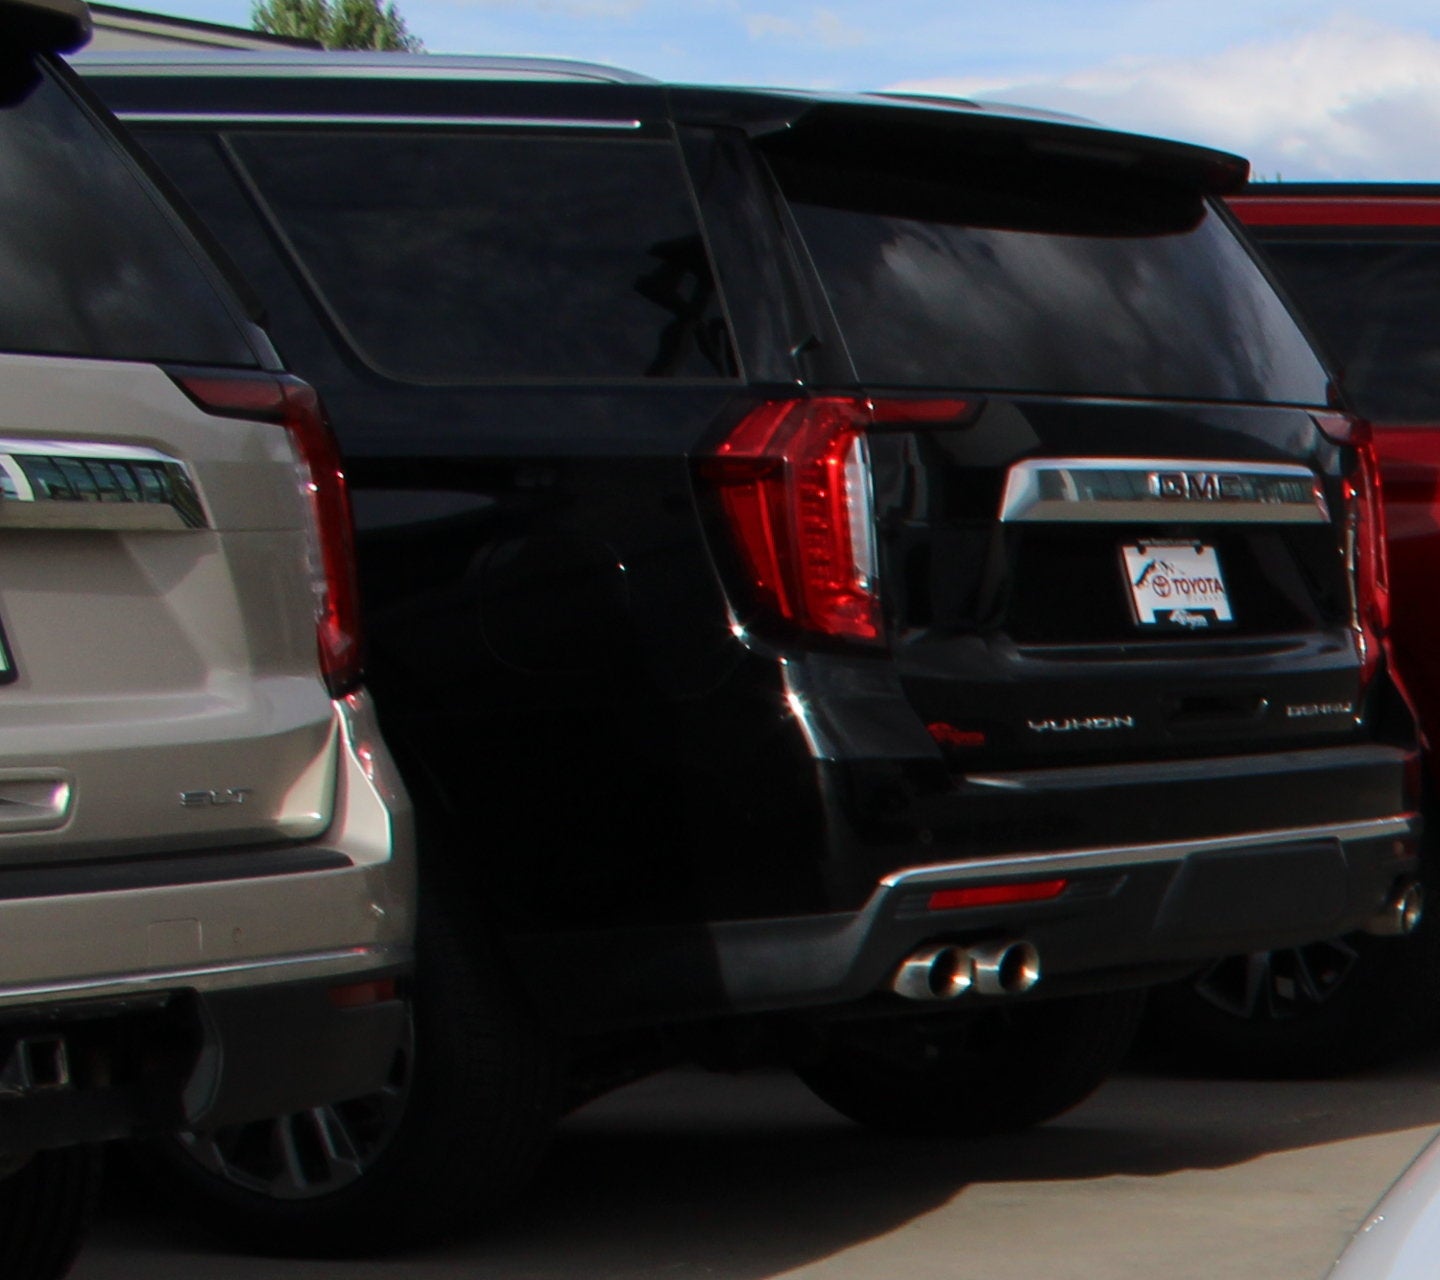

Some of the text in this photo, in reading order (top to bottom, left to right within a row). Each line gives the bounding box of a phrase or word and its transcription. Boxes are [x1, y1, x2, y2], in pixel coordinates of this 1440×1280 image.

[1152, 472, 1241, 500] GMC
[1174, 577, 1225, 596] TOYOTA
[1027, 714, 1135, 732] YUKON
